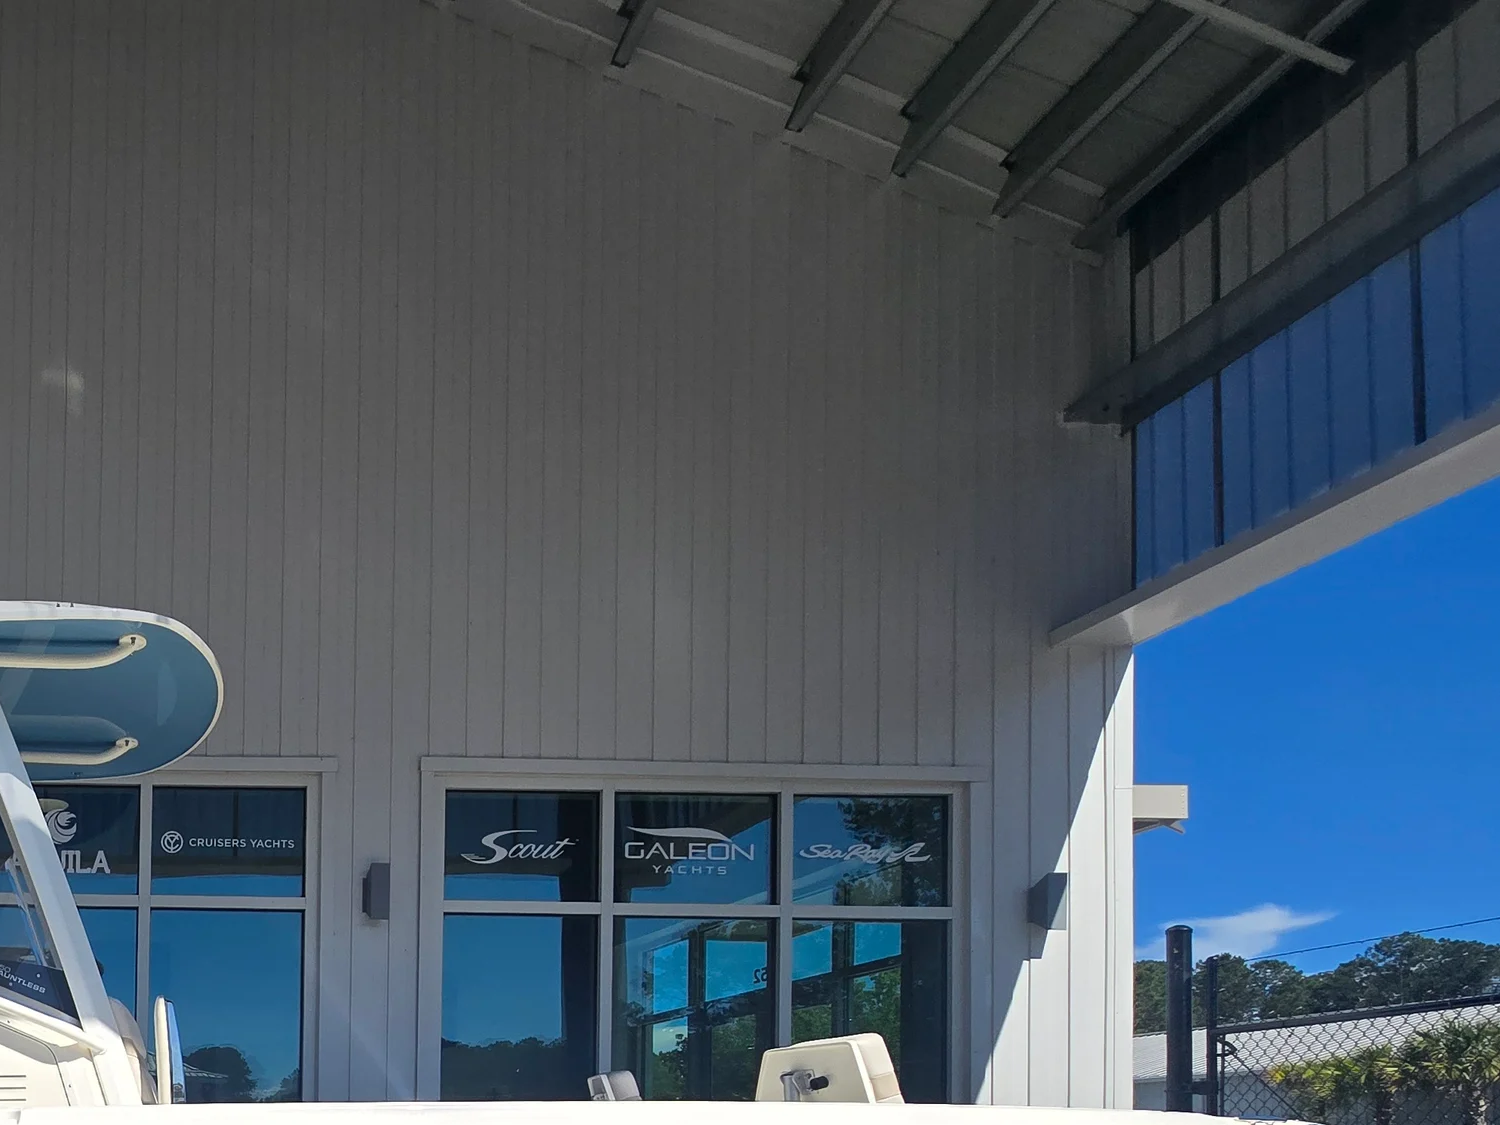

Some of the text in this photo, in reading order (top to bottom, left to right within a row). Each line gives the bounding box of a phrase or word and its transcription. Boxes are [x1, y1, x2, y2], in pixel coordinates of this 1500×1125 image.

[188, 837, 296, 849] CRUISERS YACHTS
[460, 829, 576, 864] Scout
[624, 841, 755, 861] GALEON
[799, 843, 892, 864] Sea Ray
[652, 864, 728, 876] YACHTS
